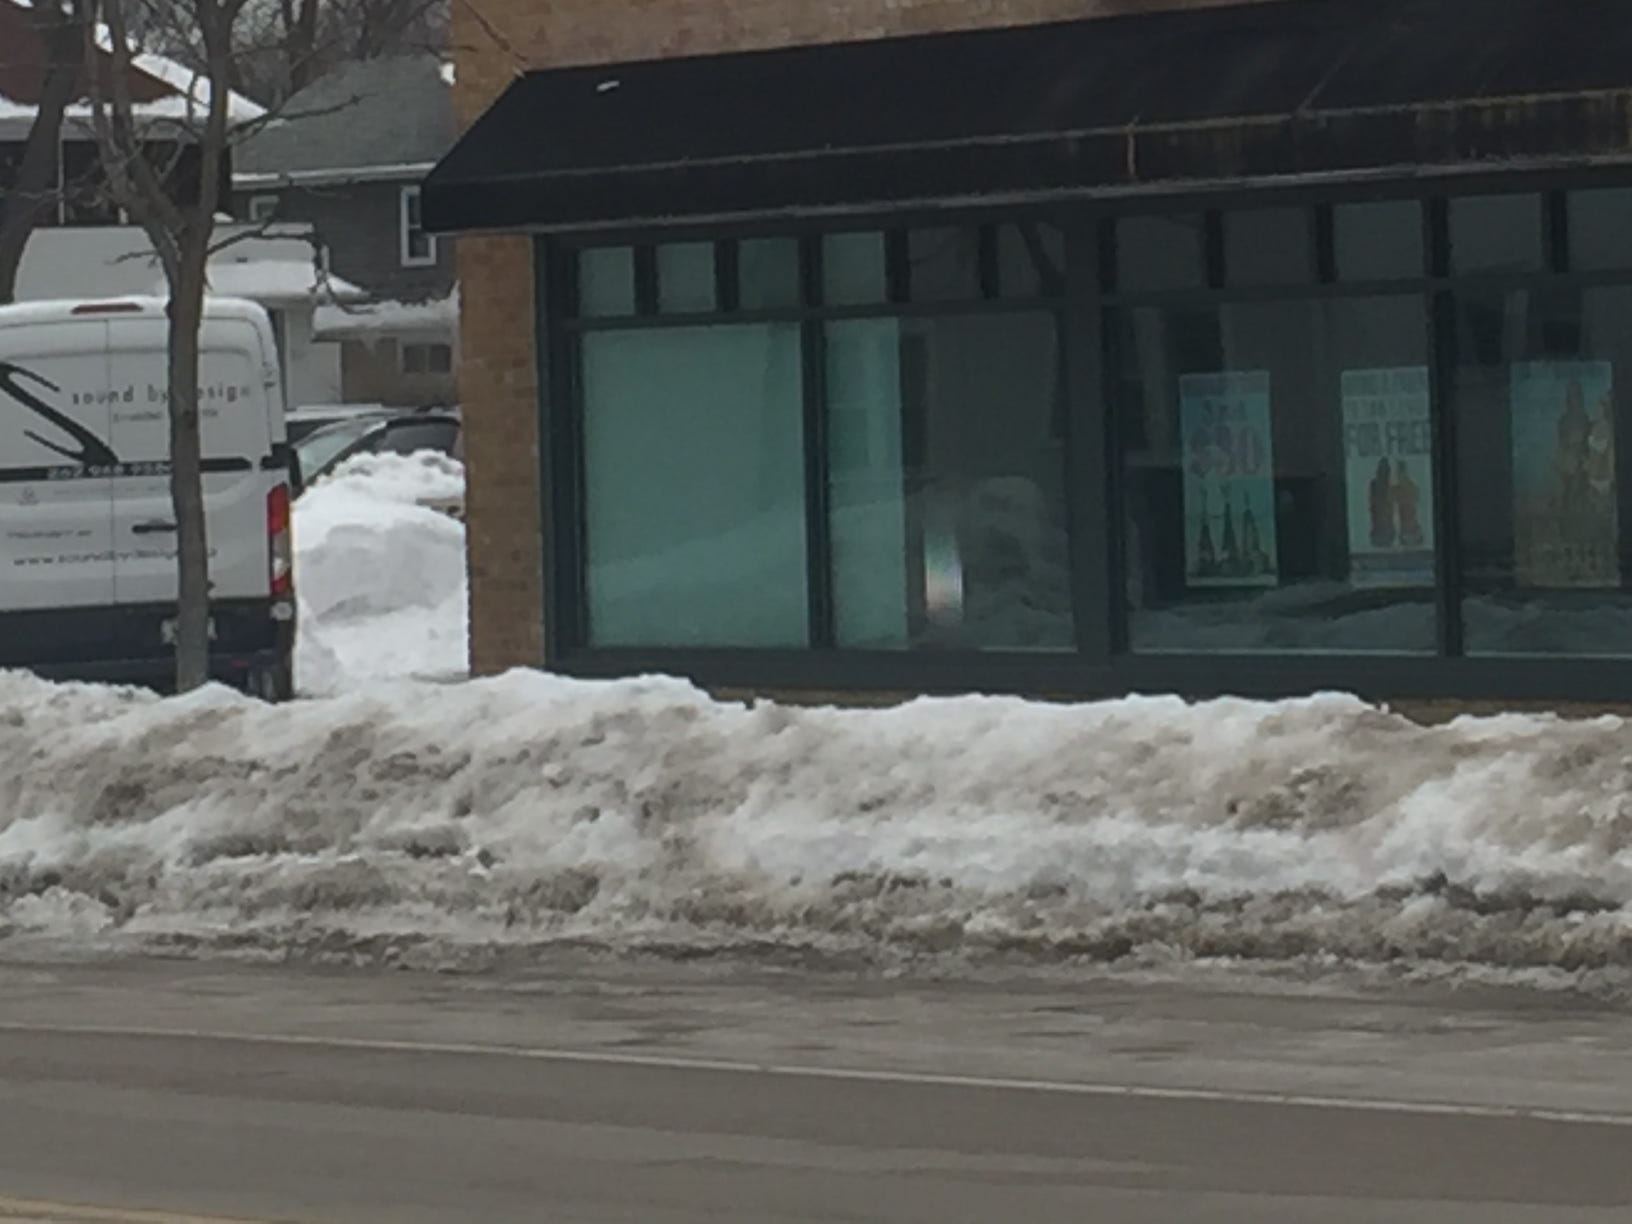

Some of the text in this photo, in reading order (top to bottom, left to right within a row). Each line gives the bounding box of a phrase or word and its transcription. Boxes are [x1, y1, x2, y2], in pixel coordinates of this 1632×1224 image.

[72, 381, 251, 405] sound by esign
